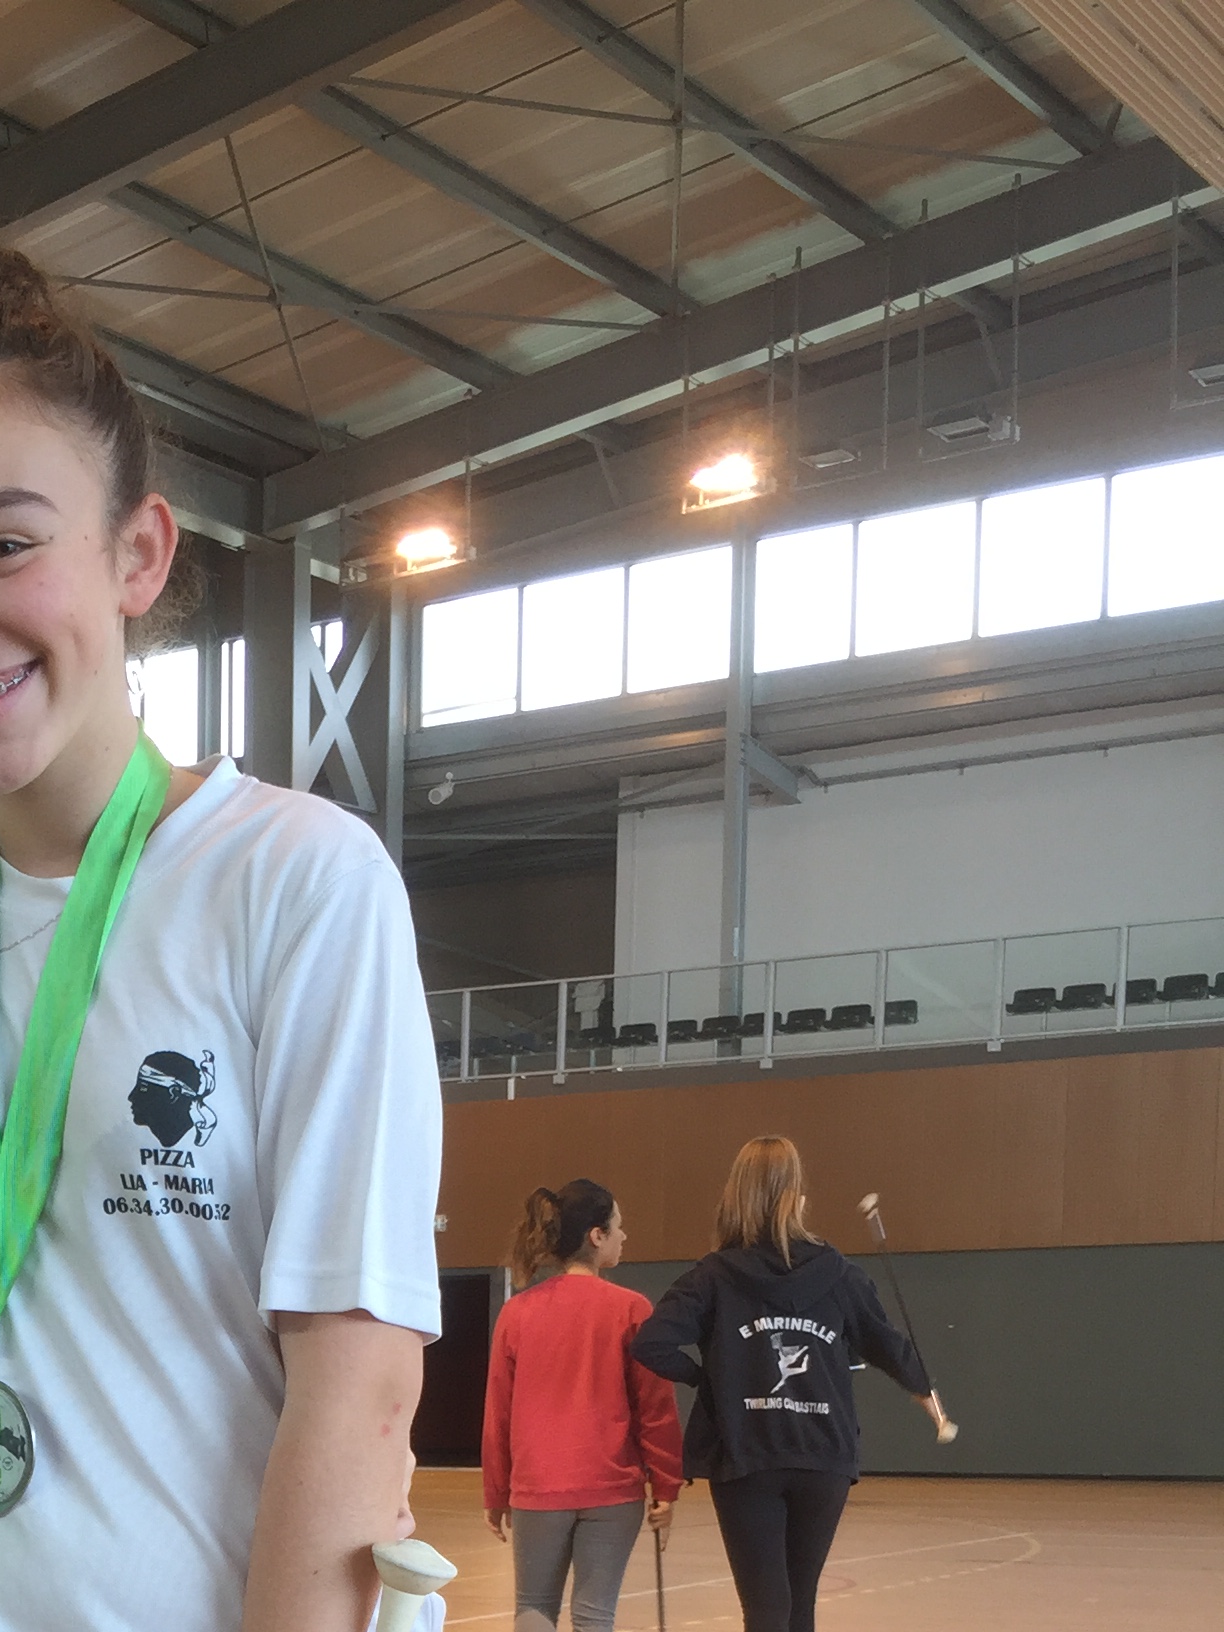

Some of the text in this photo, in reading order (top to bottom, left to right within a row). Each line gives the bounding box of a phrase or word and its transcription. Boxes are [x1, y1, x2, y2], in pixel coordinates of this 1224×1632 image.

[140, 1148, 195, 1168] PIZZA
[738, 1316, 837, 1344] E MARINELLE
